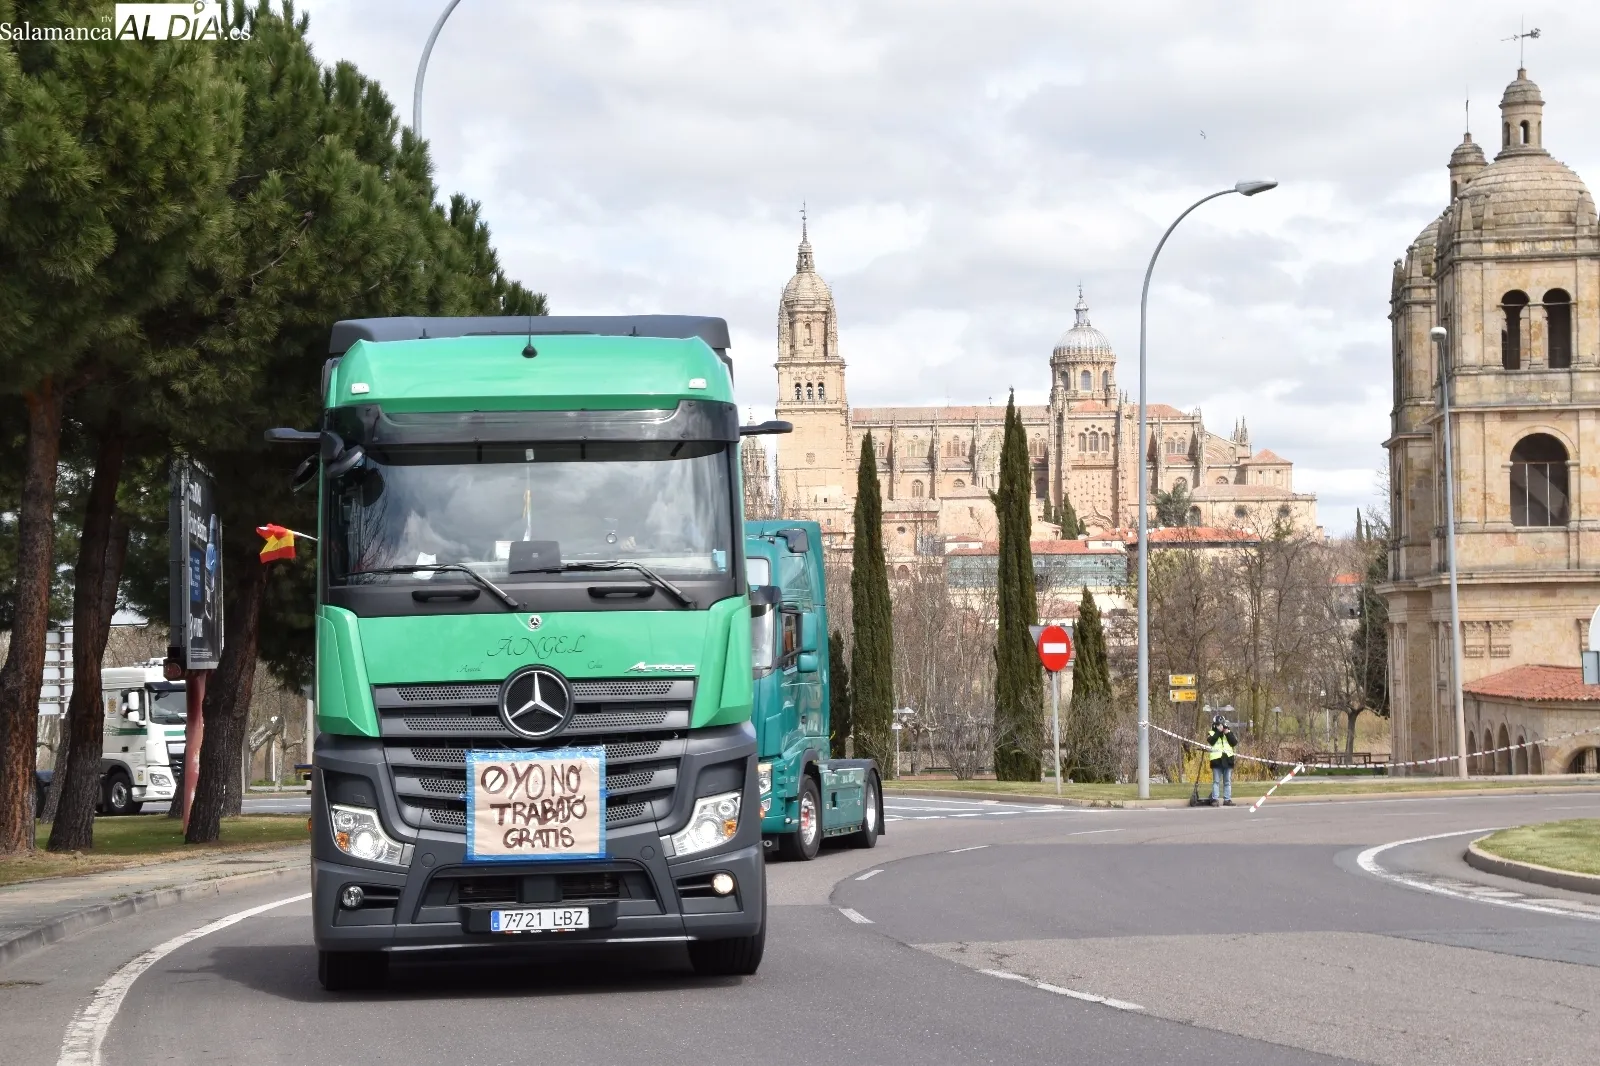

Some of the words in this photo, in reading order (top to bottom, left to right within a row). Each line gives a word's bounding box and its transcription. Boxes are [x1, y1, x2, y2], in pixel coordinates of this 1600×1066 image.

[551, 763, 582, 797] NO
[490, 795, 587, 826] TRABAJO
[502, 826, 575, 849] GRATIS
[504, 912, 542, 929] 7721
[553, 910, 583, 926] LBZ
